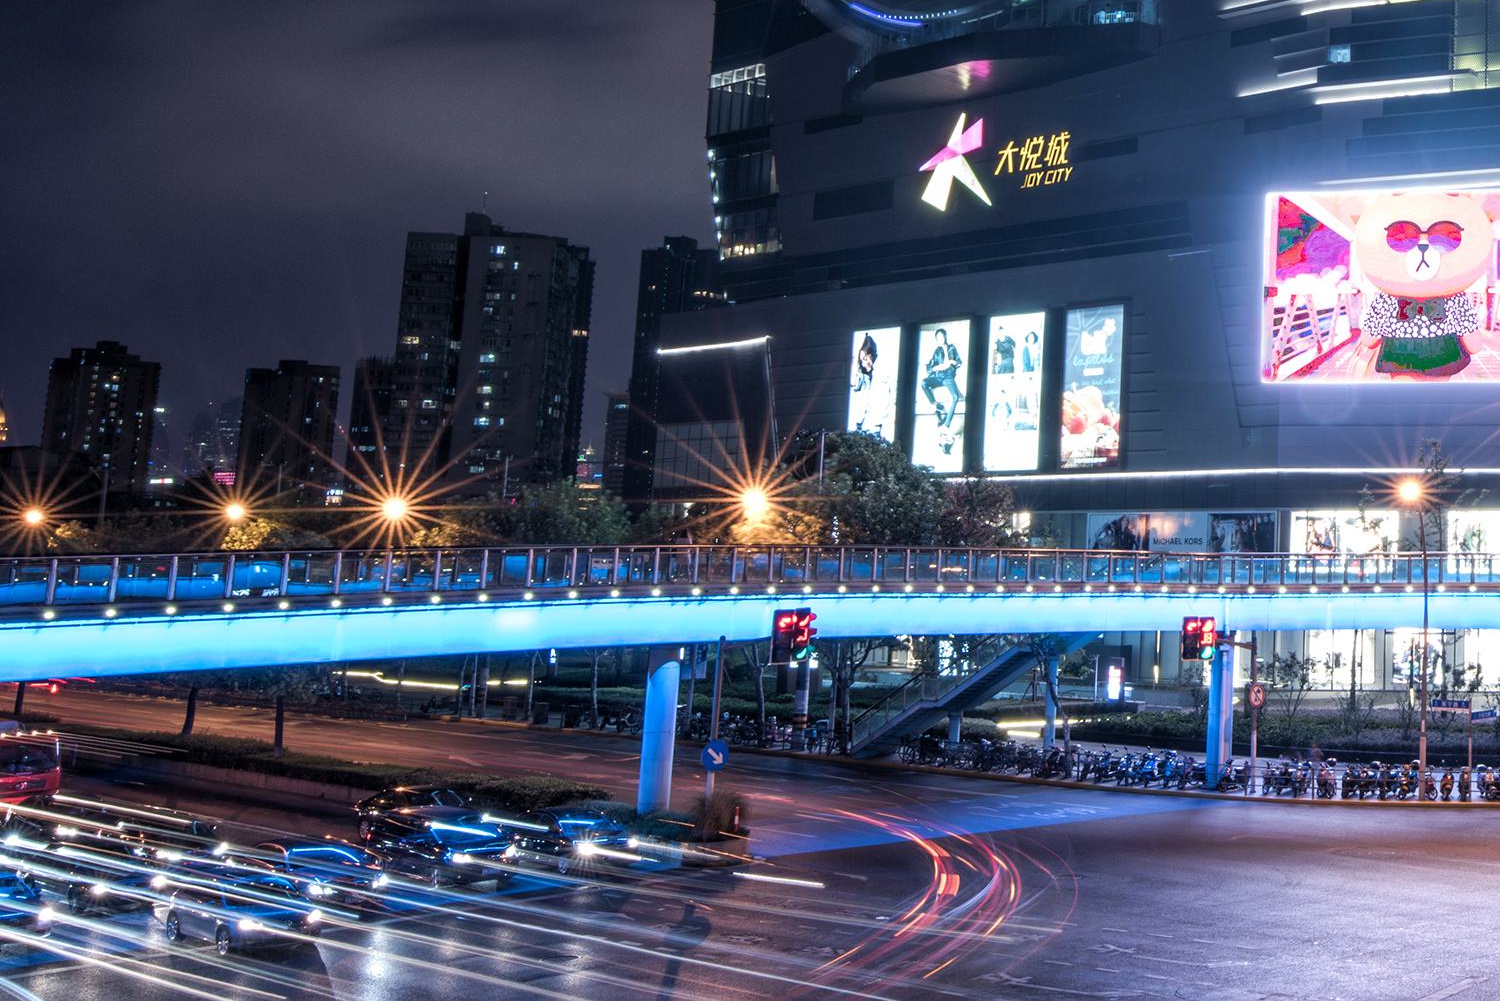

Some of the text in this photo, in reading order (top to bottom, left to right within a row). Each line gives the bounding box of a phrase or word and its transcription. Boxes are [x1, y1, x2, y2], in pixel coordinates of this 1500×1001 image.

[994, 131, 1070, 175] 大悦城
[1020, 167, 1073, 189] JOY CITY
[1153, 537, 1203, 545] MICHAEL KORS
